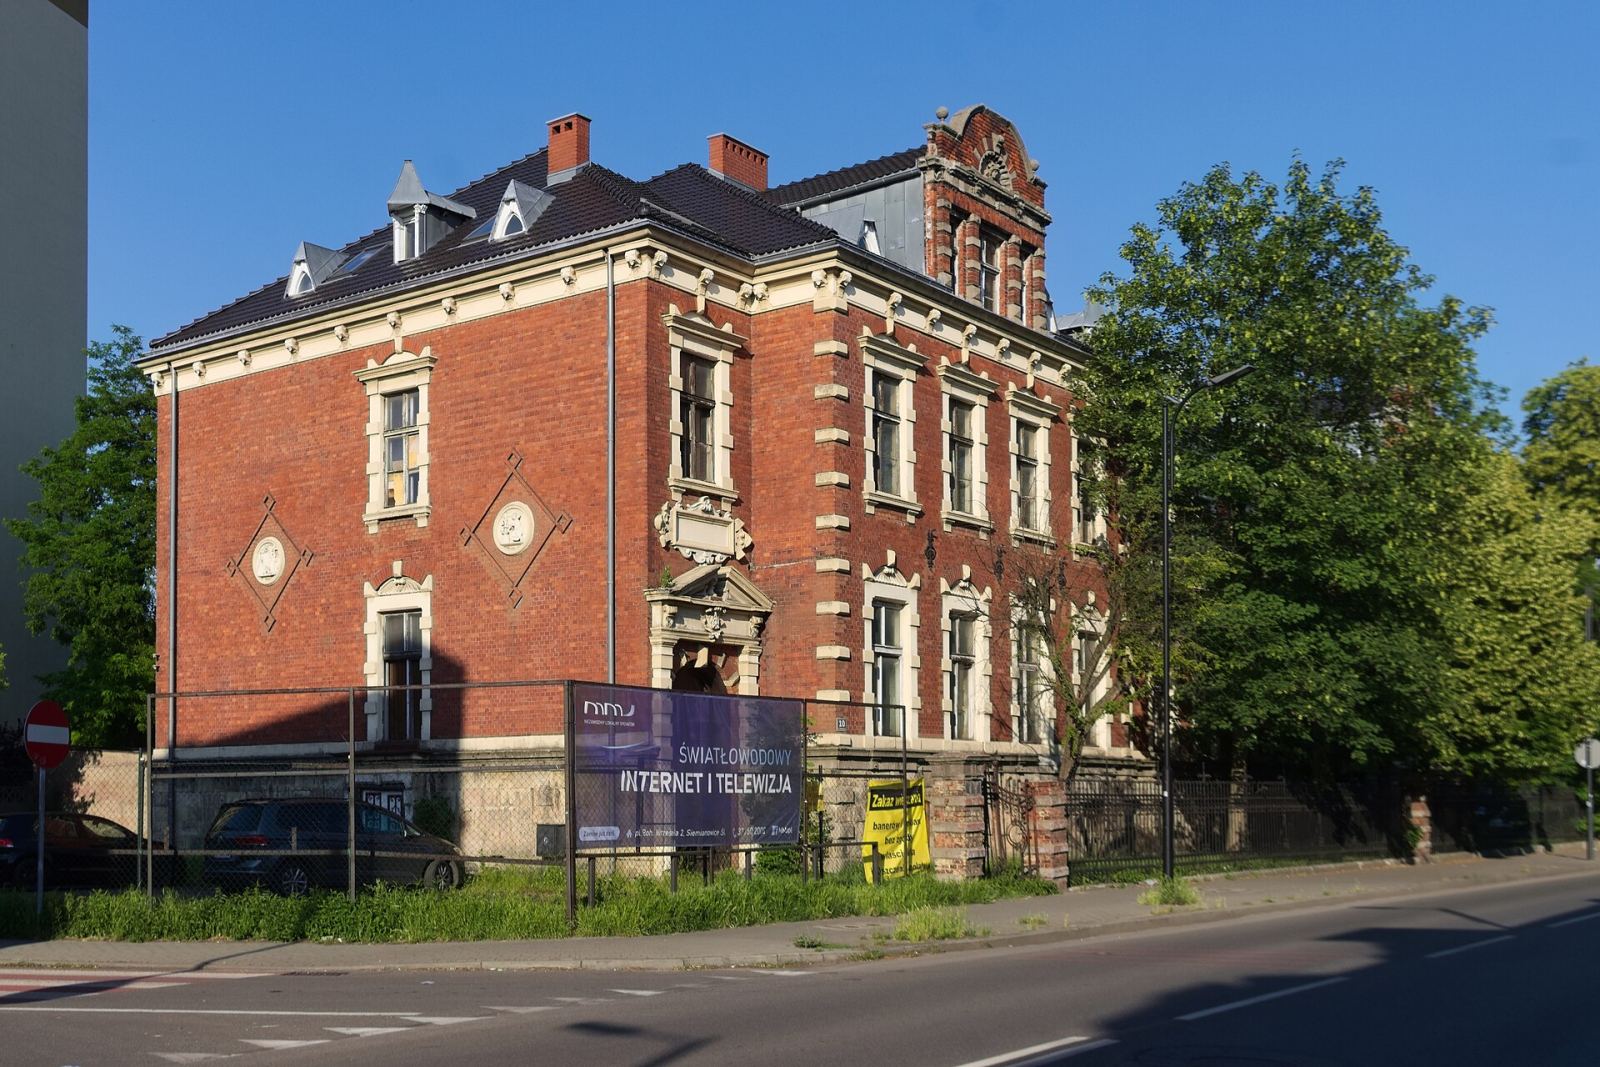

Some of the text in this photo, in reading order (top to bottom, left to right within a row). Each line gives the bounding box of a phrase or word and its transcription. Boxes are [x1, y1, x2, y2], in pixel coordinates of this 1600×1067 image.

[679, 742, 792, 766] ŚWIATŁOWODOWY
[620, 770, 792, 794] INTERNET I TELEWIZJA
[872, 793, 895, 807] Zakaz
